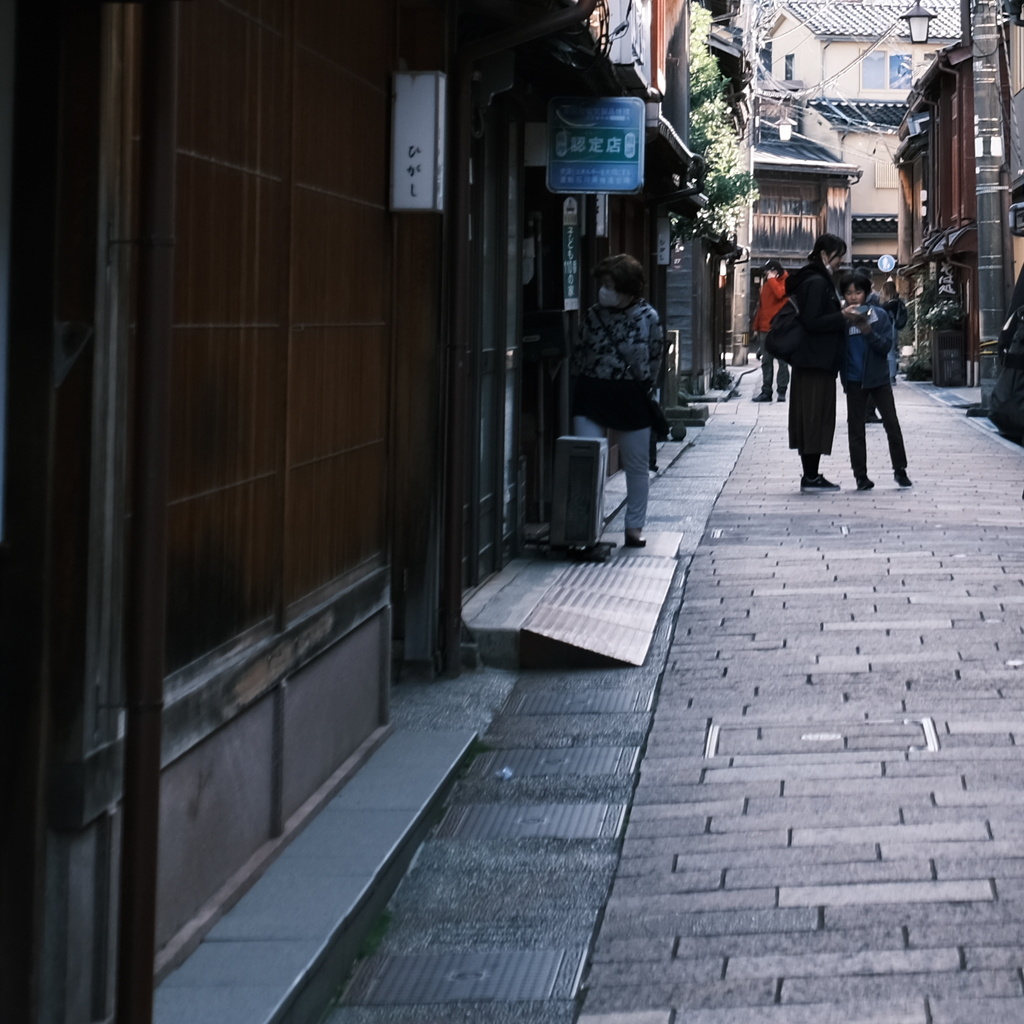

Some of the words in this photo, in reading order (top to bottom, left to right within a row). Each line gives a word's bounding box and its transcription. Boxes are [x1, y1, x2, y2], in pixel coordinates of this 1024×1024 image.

[570, 136, 622, 154] 認定店
[407, 145, 422, 198] ひがし
[938, 261, 957, 295] そば処
